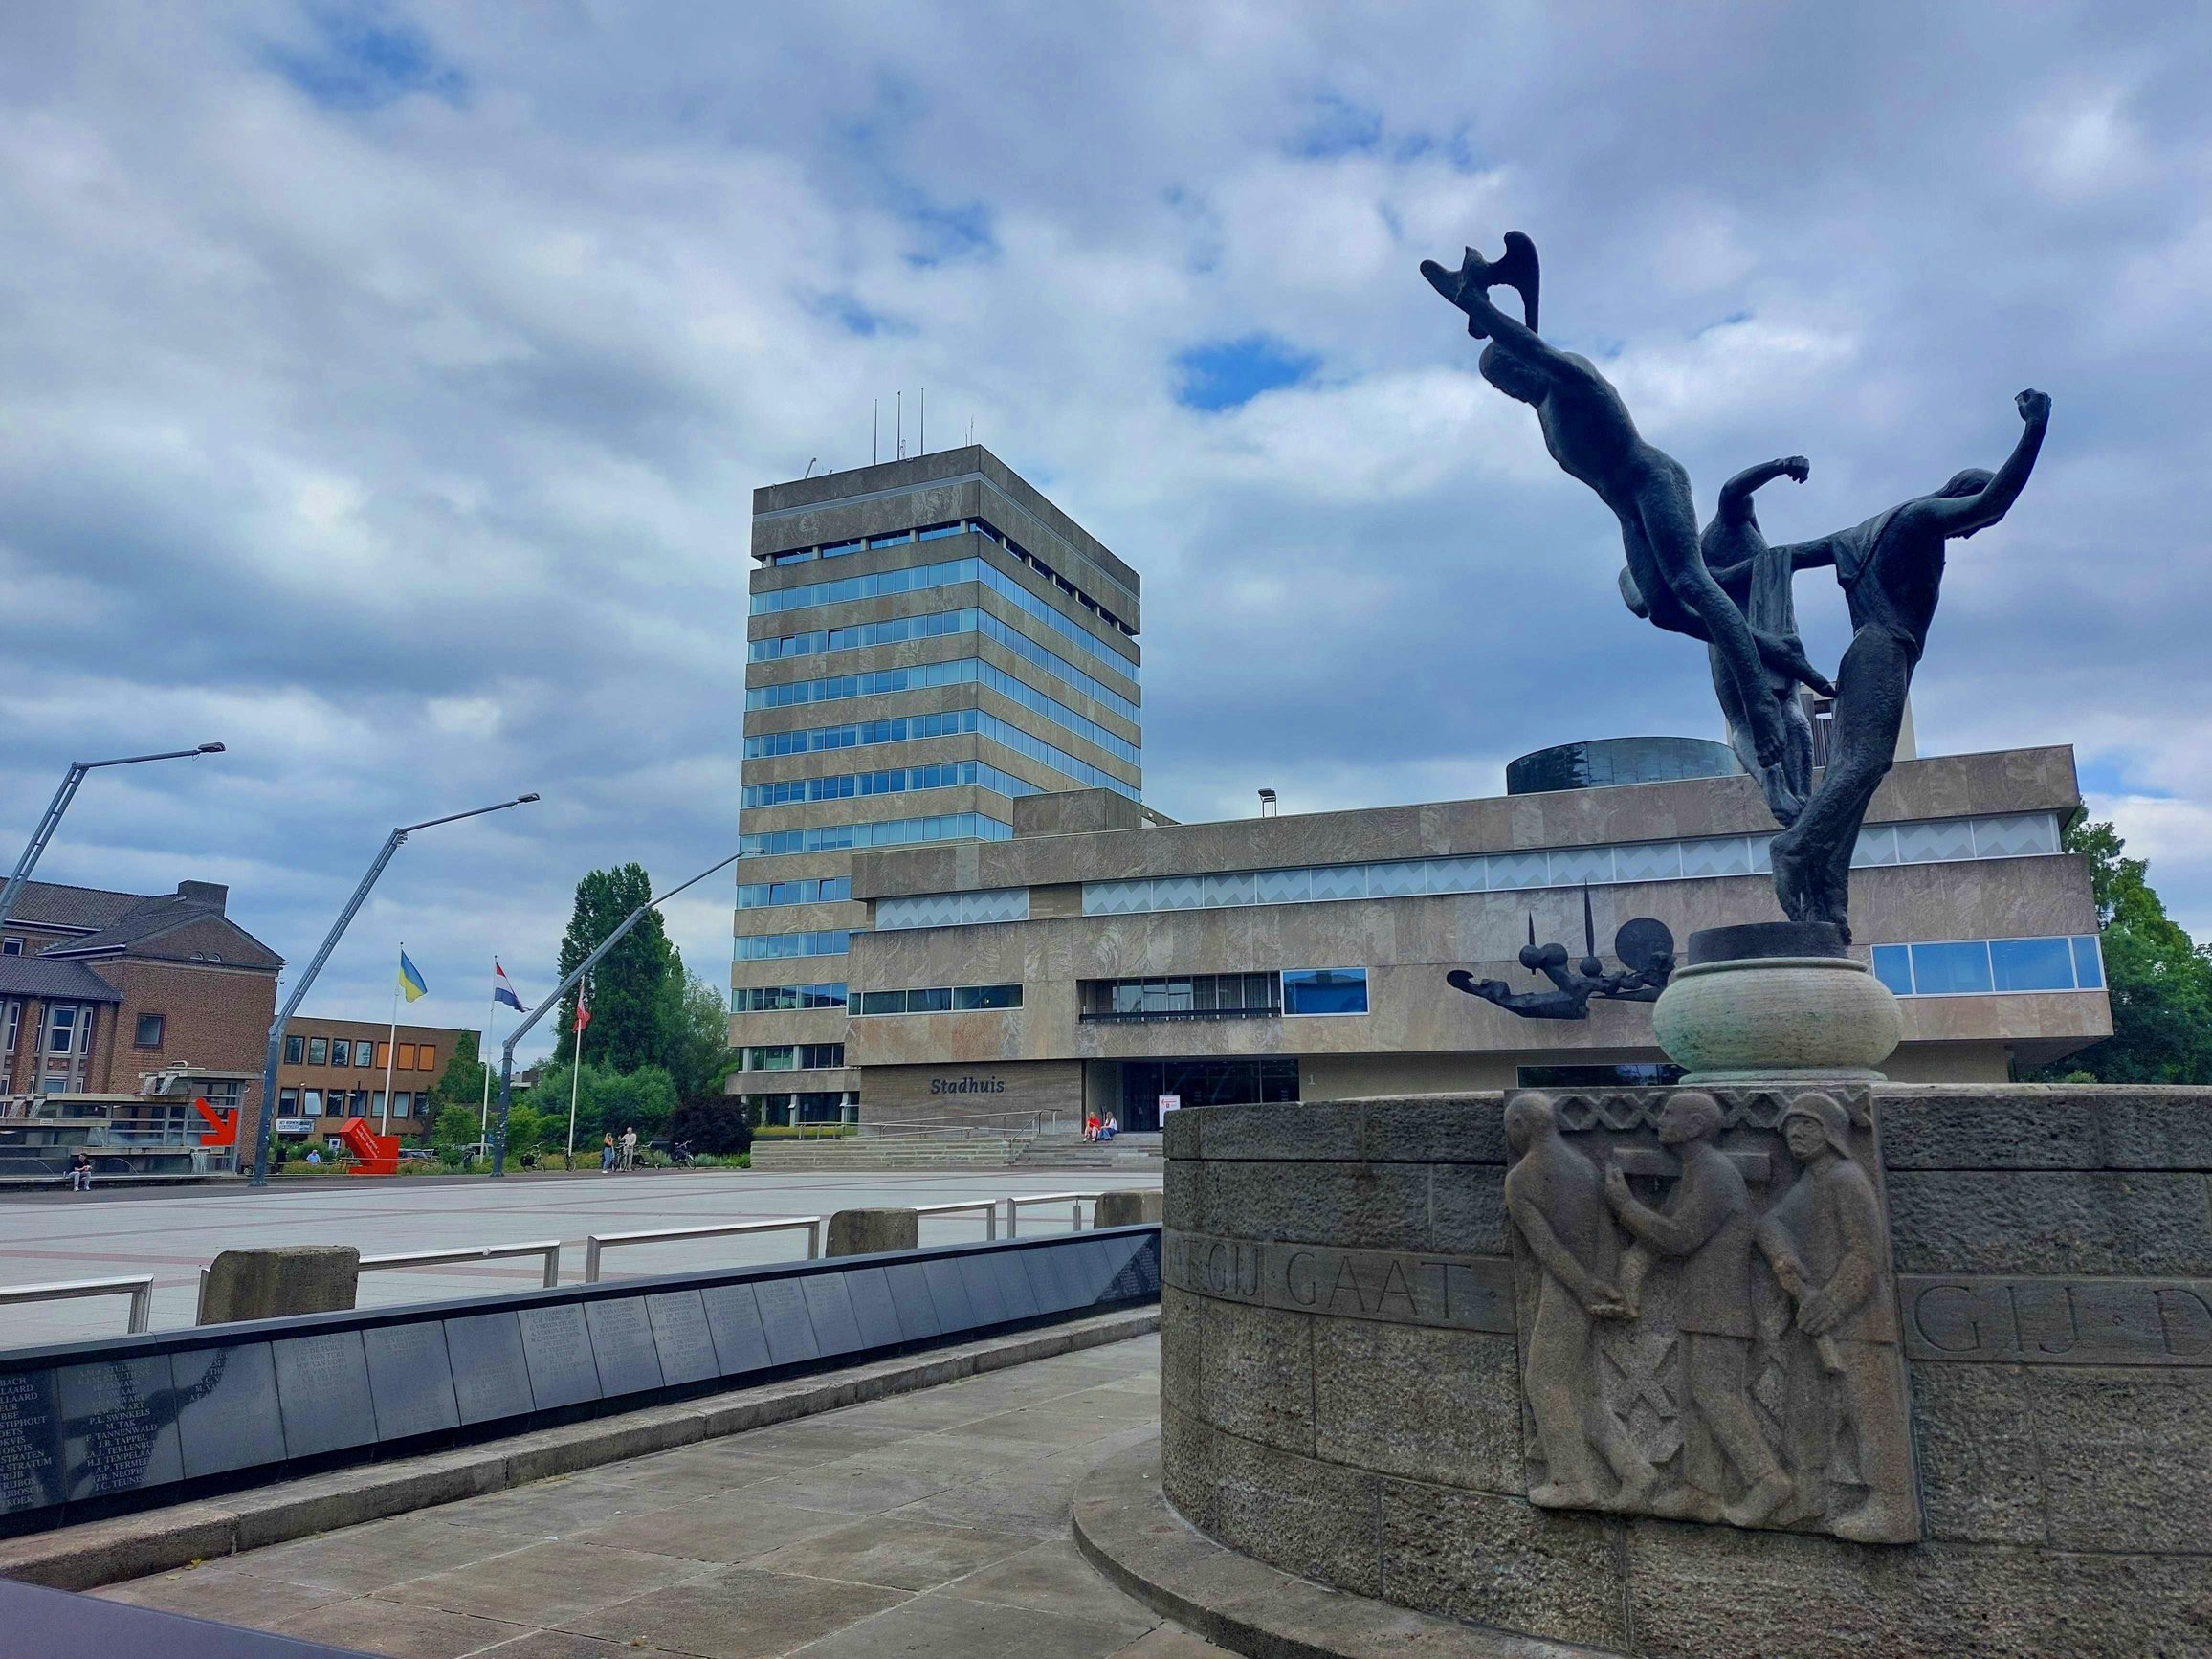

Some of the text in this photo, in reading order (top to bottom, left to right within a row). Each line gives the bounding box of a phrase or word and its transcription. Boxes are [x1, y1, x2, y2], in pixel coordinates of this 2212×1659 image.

[931, 1075, 1005, 1095] Stadhuis
[1308, 1074, 1316, 1085] 1
[1208, 1243, 1259, 1297] GIJ
[1286, 1252, 1472, 1319] GAAT
[1914, 1285, 2079, 1355] GIJ
[115, 1401, 144, 1412] SWART
[0, 1415, 47, 1429] STIPHOUT
[106, 1408, 151, 1423] SWINKELS
[118, 1419, 136, 1428] TAK
[97, 1423, 158, 1441] TANNENWALD
[115, 1433, 147, 1446] TAPPEL
[106, 1439, 160, 1455] TEKLENBU
[0, 1449, 45, 1464] STRATEN
[6, 1456, 52, 1472] STRATUM
[104, 1449, 160, 1464] TEMPELAA
